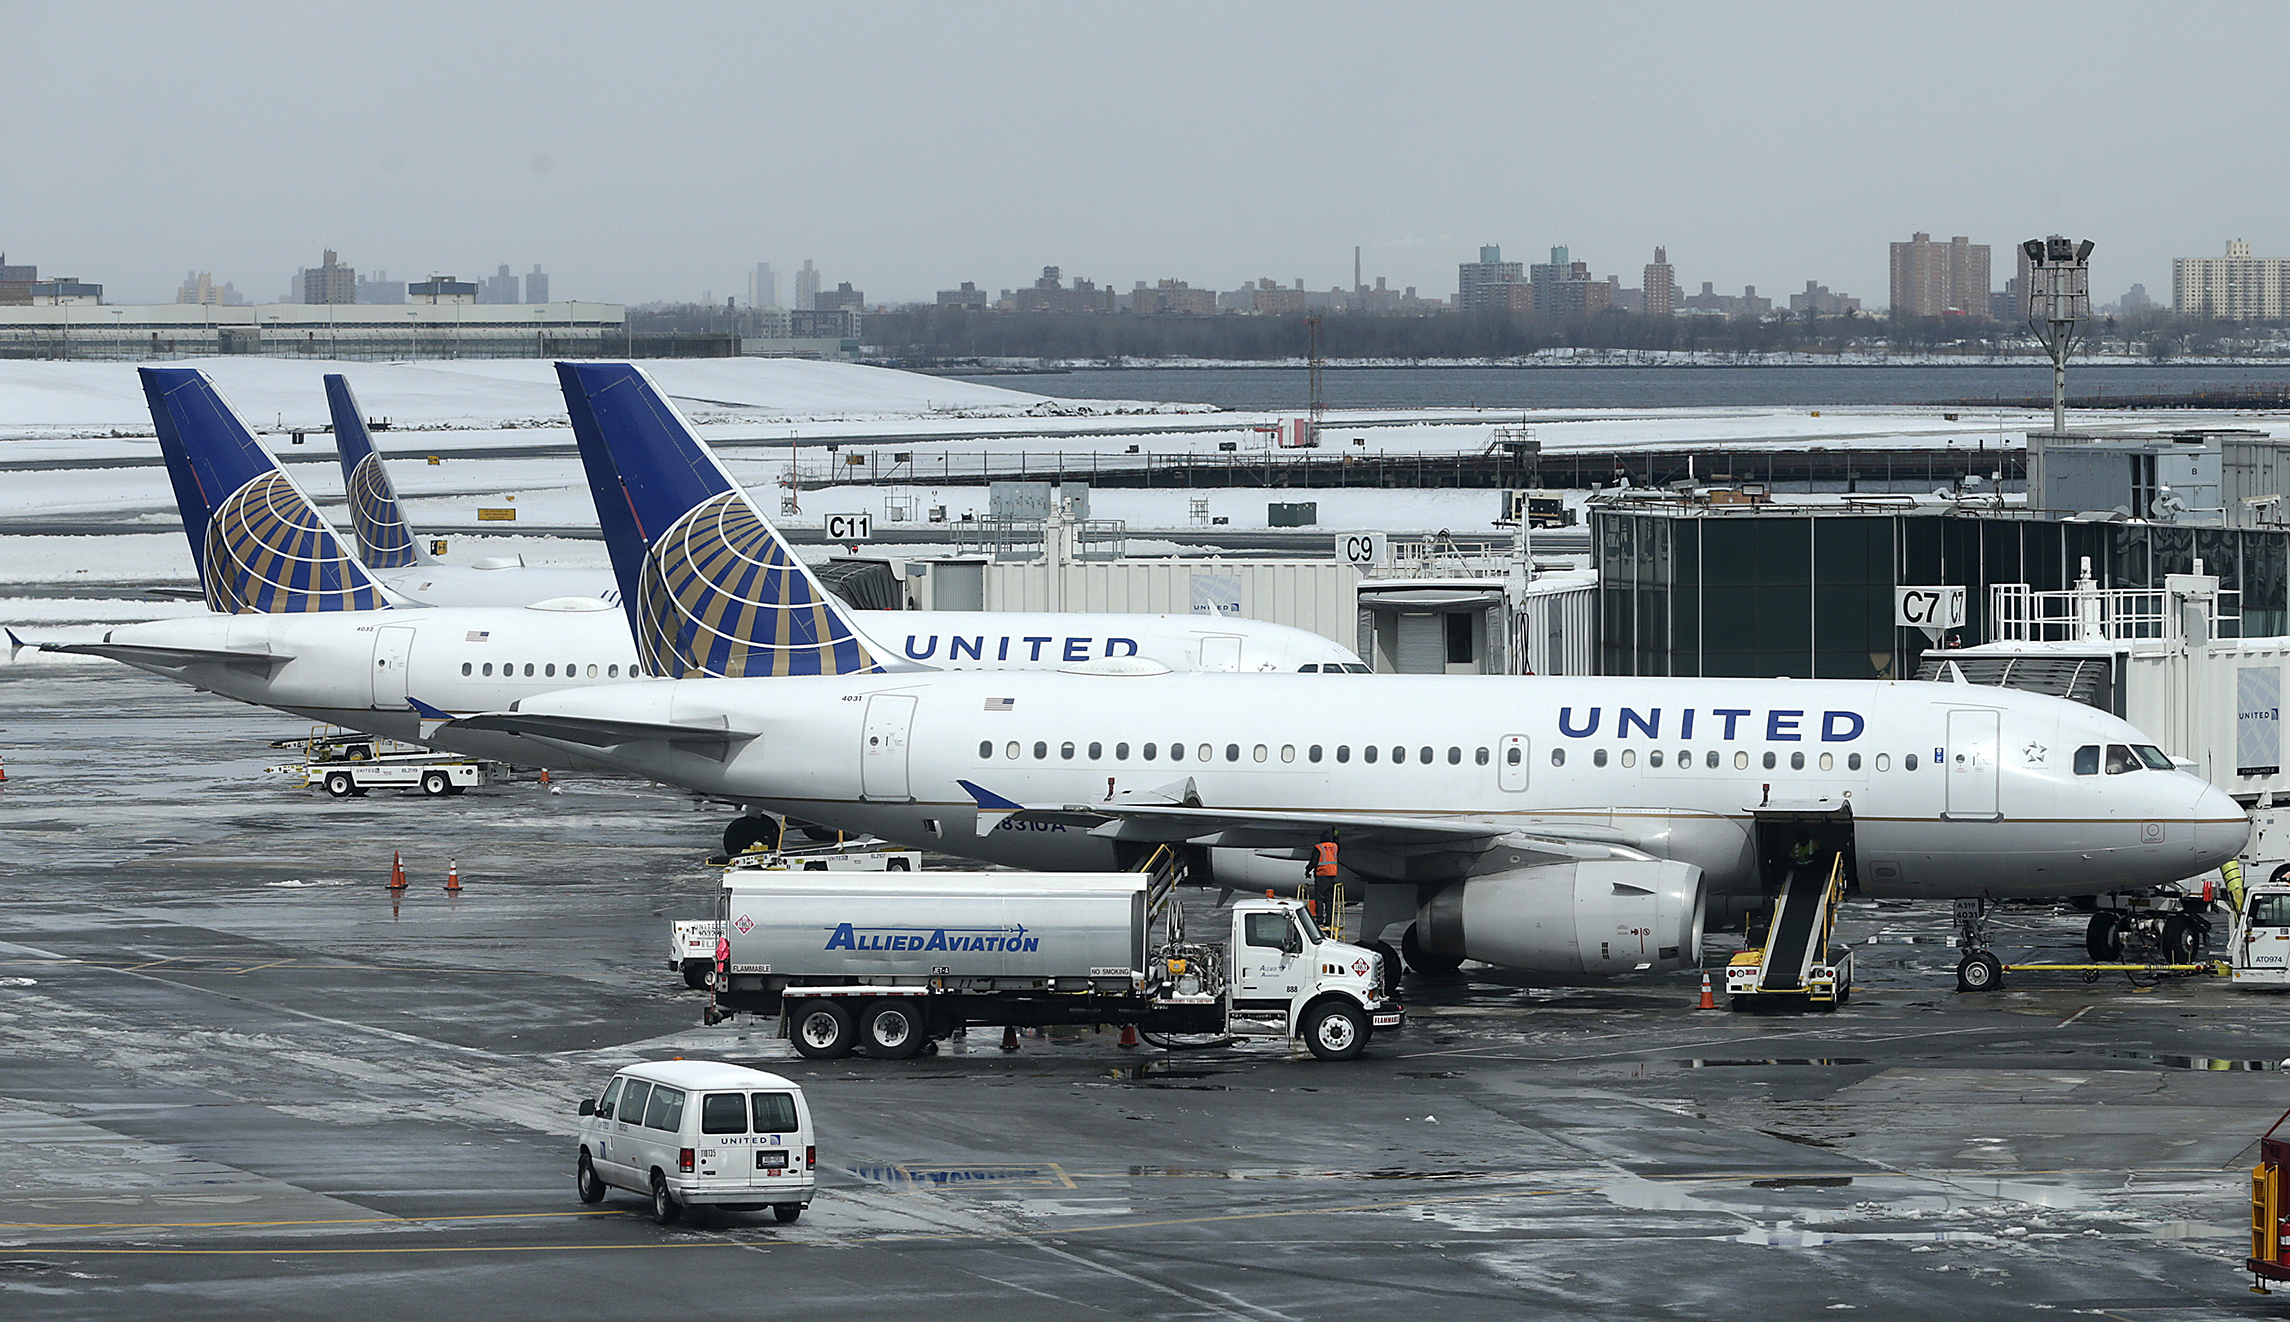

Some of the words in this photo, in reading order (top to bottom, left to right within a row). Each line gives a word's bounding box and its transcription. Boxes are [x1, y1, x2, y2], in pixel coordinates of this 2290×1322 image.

[2191, 467, 2197, 475] B
[829, 516, 868, 538] C11
[1347, 536, 1372, 562] C9
[1902, 590, 1941, 623] C7
[1951, 591, 1964, 623] C7
[904, 635, 1139, 662] UNITED
[1558, 706, 1866, 743] UNITED
[2238, 711, 2270, 720] UNITED
[1956, 911, 1978, 919] 4031
[732, 965, 770, 973] FLAMMABLE
[721, 1137, 767, 1145] UNITED
